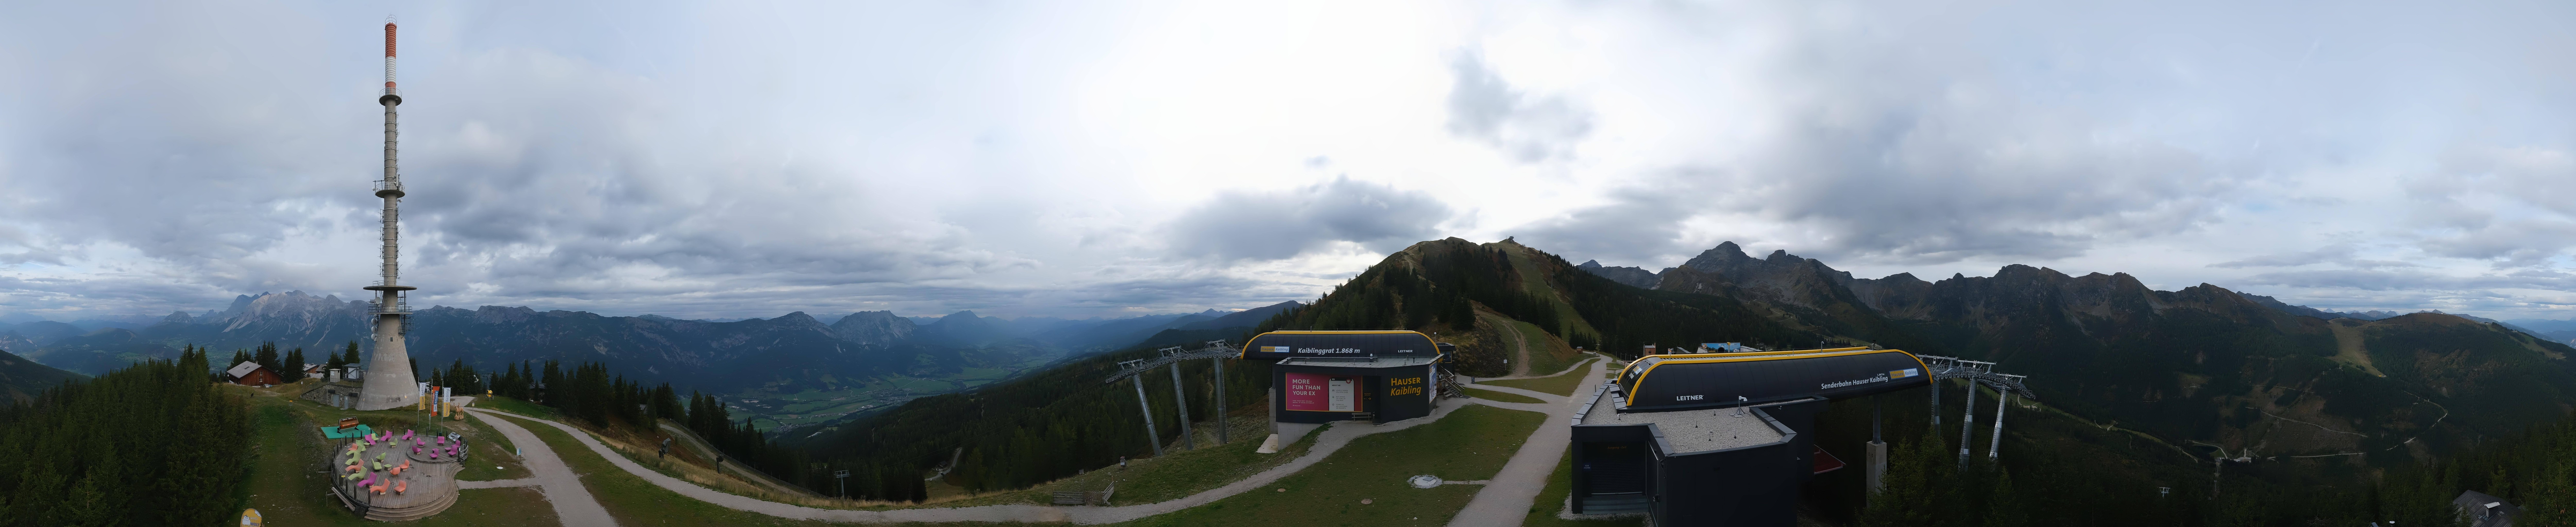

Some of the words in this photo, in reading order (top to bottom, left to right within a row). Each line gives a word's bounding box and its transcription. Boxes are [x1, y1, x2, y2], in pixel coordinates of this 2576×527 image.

[1391, 377, 1421, 386] HAUSER
[1821, 380, 1852, 389] Senderbahn
[1391, 386, 1421, 396] Kaibling
